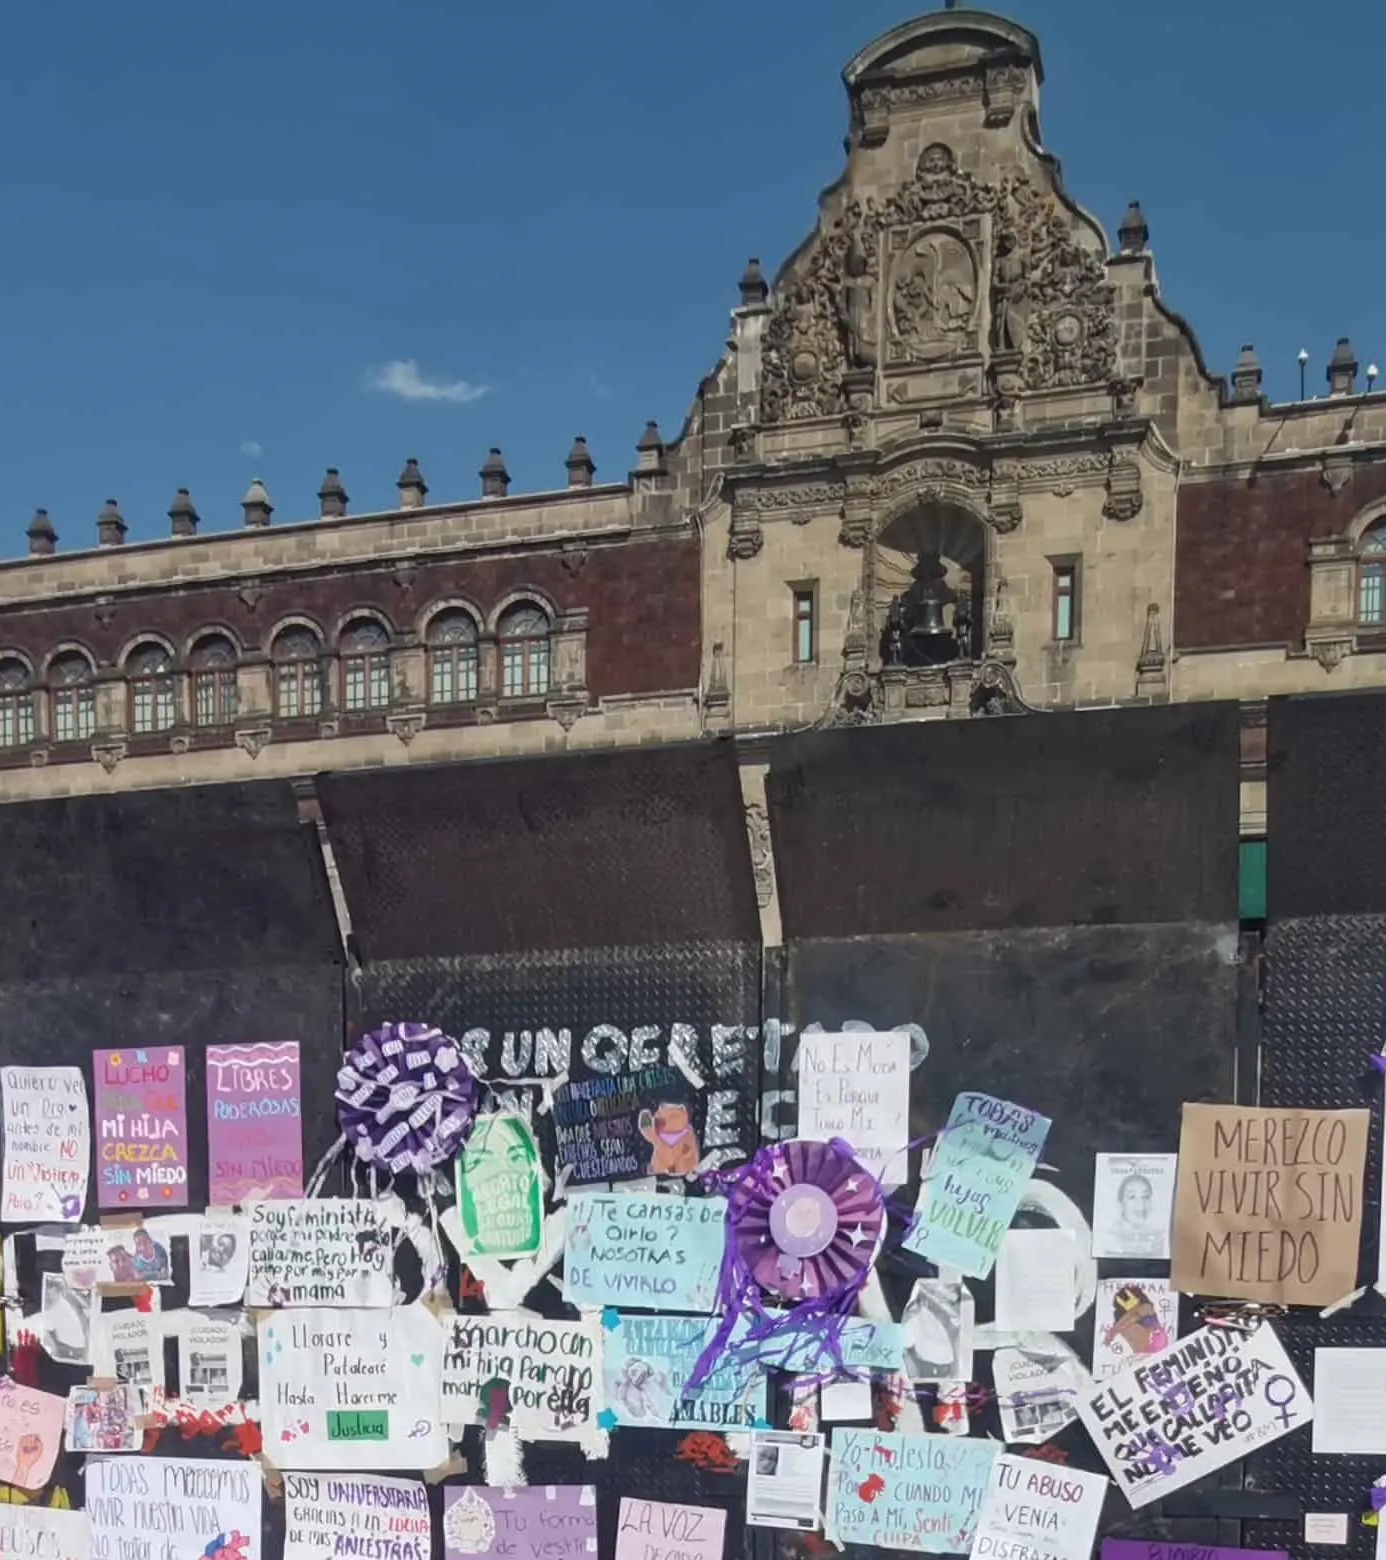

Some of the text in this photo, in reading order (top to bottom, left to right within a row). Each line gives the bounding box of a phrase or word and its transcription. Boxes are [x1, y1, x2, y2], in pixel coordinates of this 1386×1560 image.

[105, 1065, 169, 1086] LUCHO
[217, 1066, 293, 1092] LIBRES
[214, 1099, 300, 1120] PODEROSAS
[131, 1114, 178, 1139] HIJA
[102, 1144, 178, 1161] CREZCA
[1214, 1118, 1347, 1165] MEREZCO
[103, 1163, 186, 1184] SIN MIEDO
[1194, 1171, 1353, 1222] VIVIR SIN
[591, 1246, 686, 1265] NOSOTRAS
[1201, 1230, 1321, 1285] MIEDO
[570, 1266, 676, 1293] DE VIVIRLO
[1090, 1387, 1134, 1421] EL
[1203, 1411, 1251, 1445] VEO
[100, 1464, 148, 1496] TODAS
[287, 1475, 427, 1511] SOY UNIVERSITARIA
[997, 1463, 1084, 1503] TU ABUSO
[894, 1486, 951, 1503] CUANDO
[497, 1508, 595, 1530] Tu forma
[622, 1504, 705, 1543] LA VOZ
[496, 1535, 518, 1555] de
